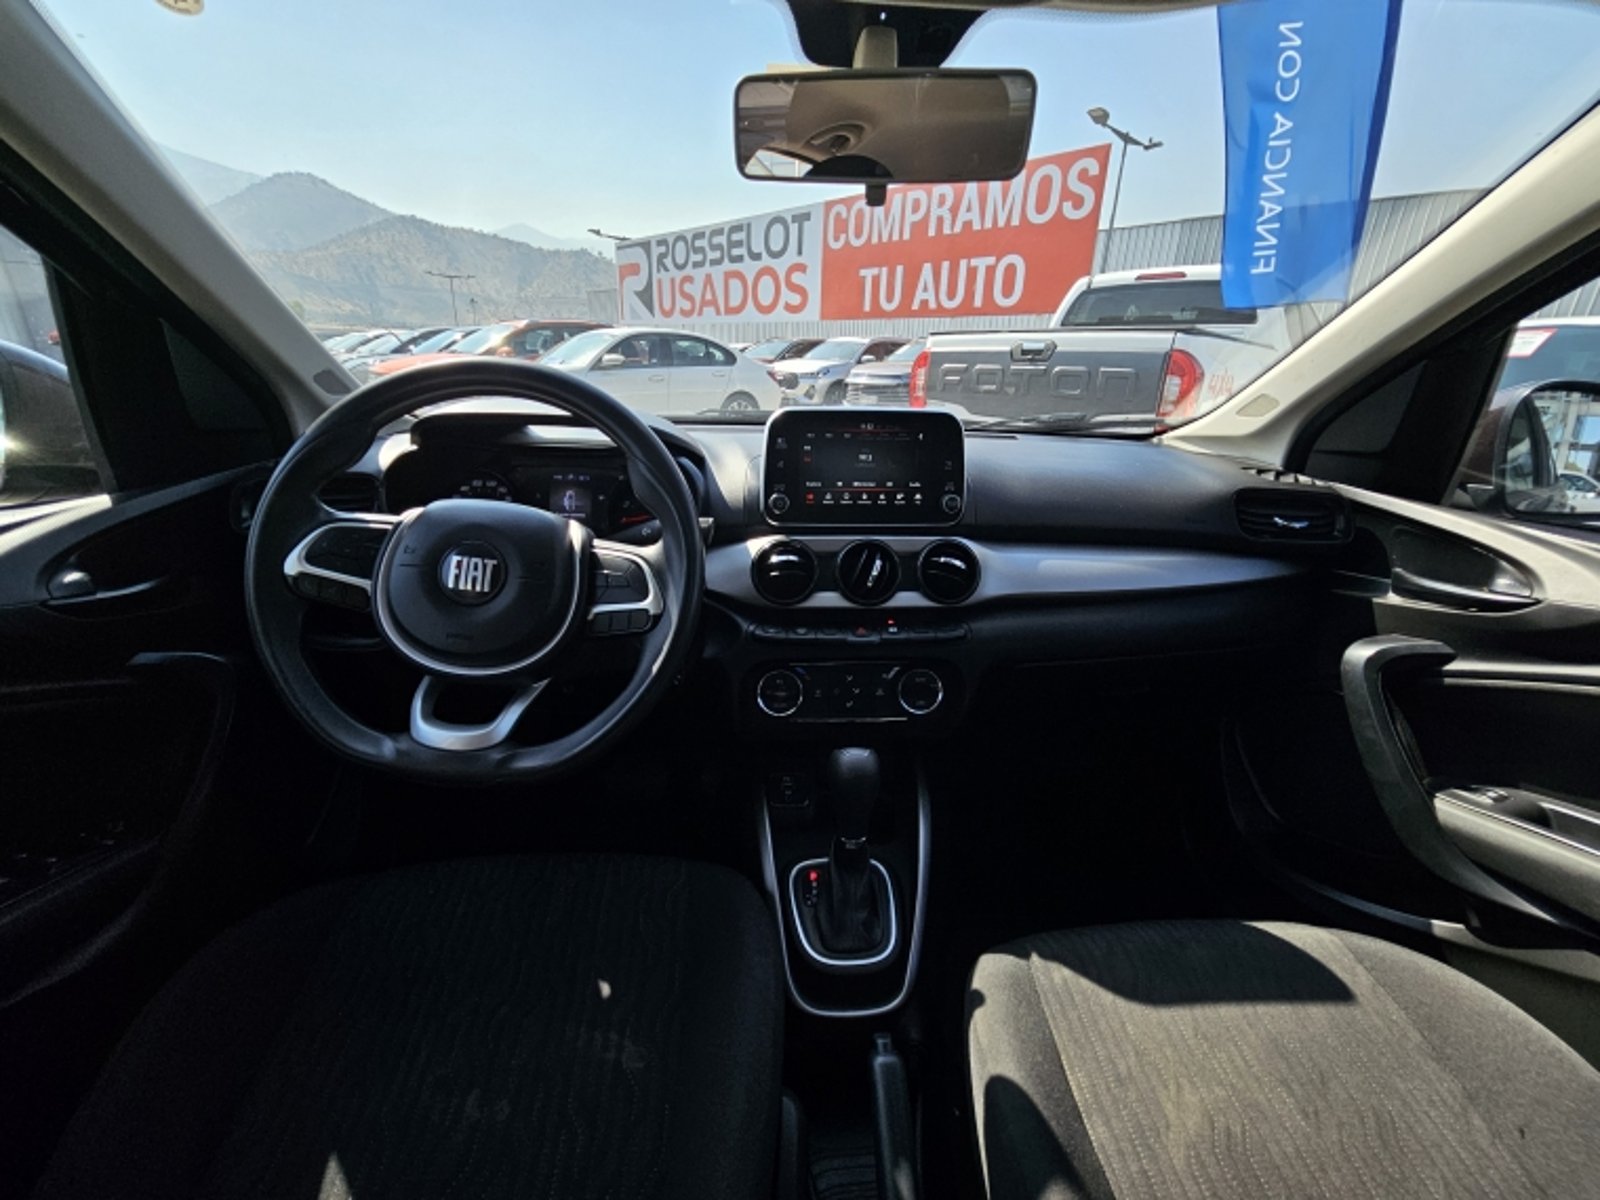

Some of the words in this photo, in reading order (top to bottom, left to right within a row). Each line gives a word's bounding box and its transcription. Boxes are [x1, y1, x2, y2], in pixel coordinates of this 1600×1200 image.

[827, 157, 1100, 250] COMPRAMOS
[656, 211, 812, 274] ROSSELOT
[656, 262, 810, 319] USADOS
[858, 265, 904, 313] TU
[911, 254, 1027, 311] AUTO
[447, 554, 498, 593] FIAT
